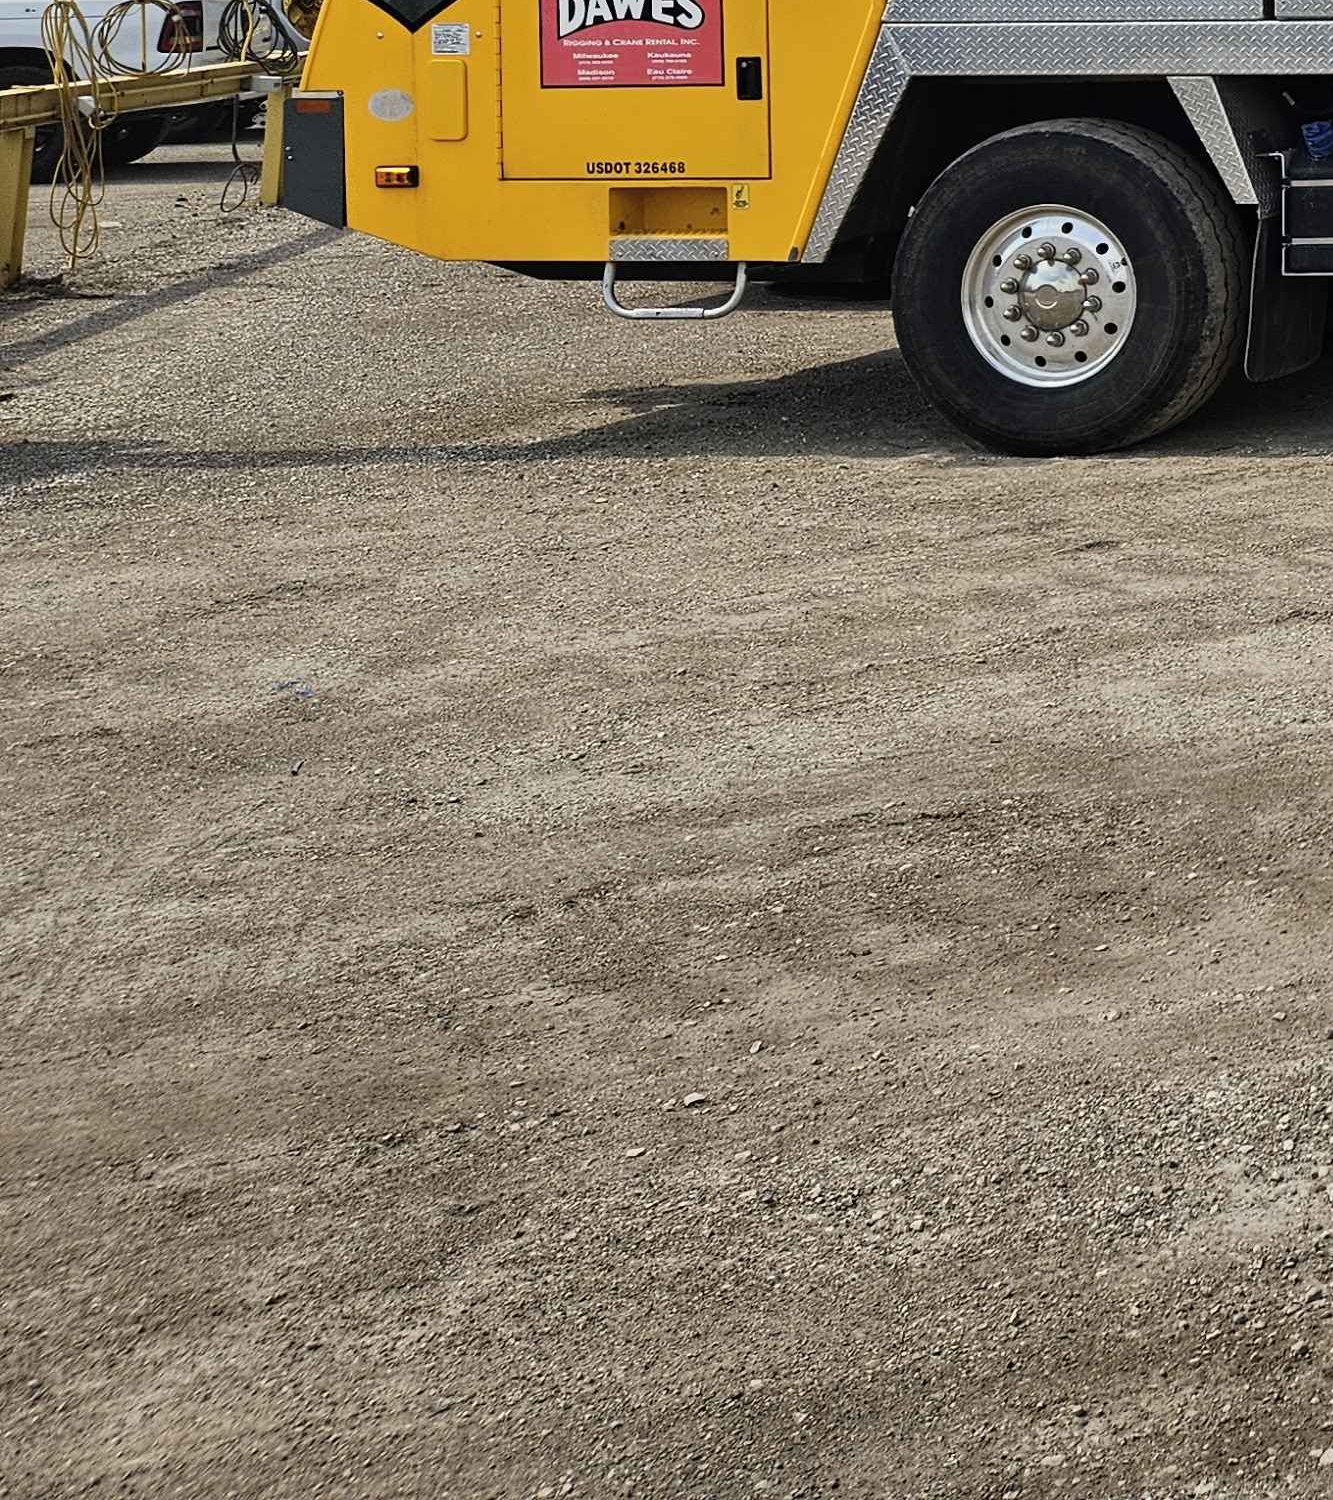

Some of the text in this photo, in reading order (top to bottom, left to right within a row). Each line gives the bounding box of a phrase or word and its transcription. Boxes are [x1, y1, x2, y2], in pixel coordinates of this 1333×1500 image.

[612, 38, 643, 46] CRANE
[586, 162, 686, 174] USDOT 326468
